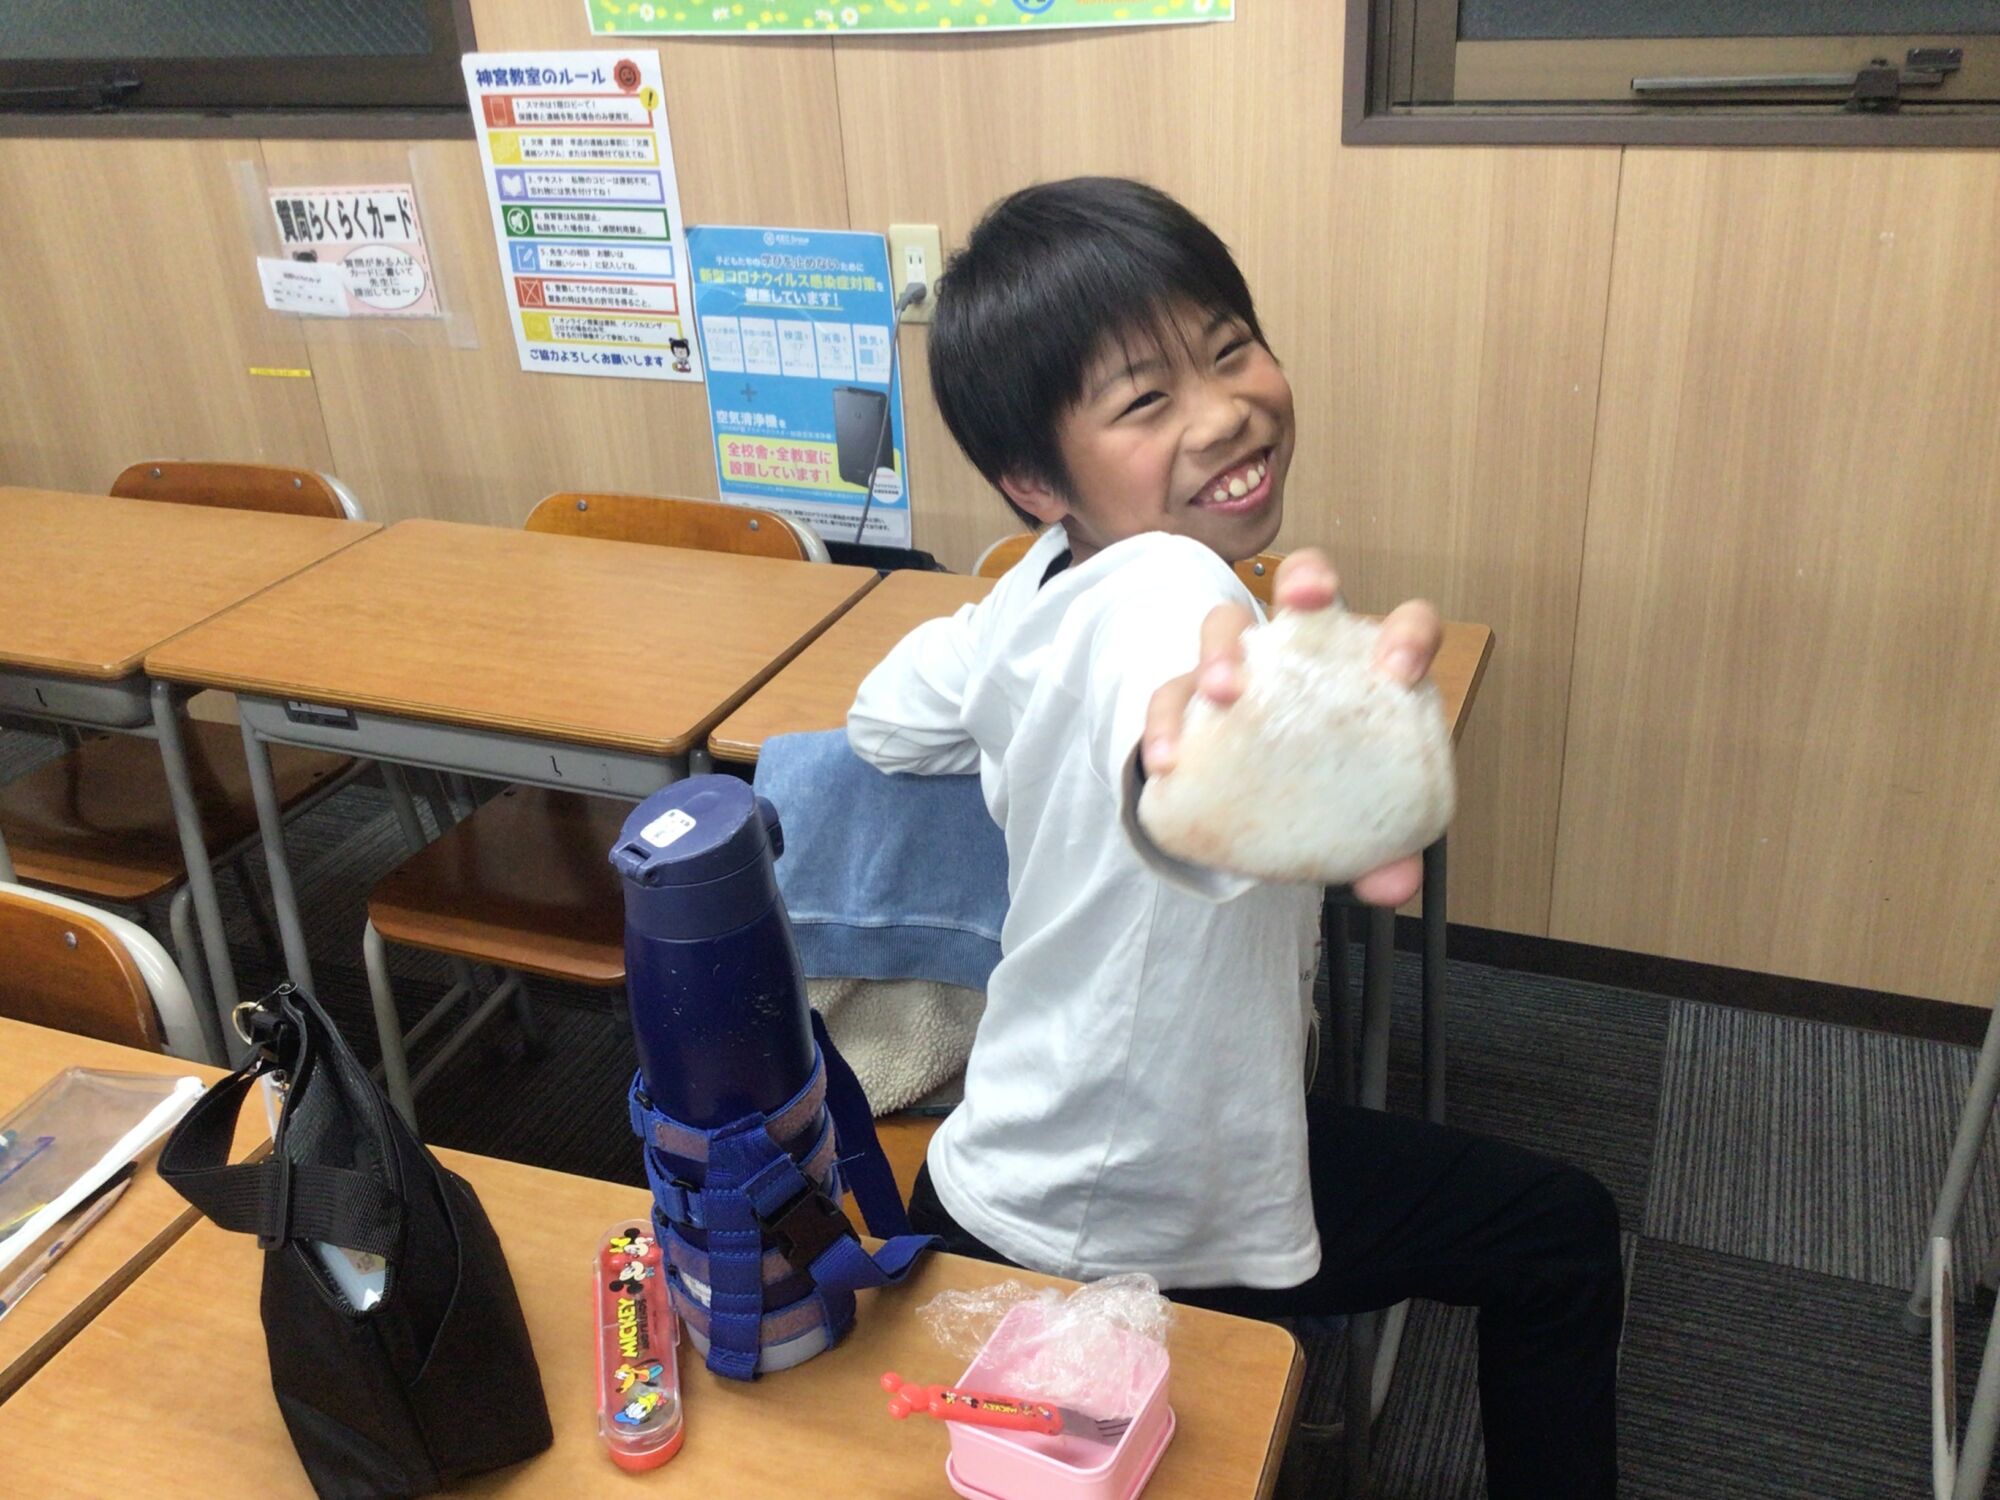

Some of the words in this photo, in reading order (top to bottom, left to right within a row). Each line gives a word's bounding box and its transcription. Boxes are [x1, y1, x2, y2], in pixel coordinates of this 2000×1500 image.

[476, 67, 606, 87] 神宮教室のルール
[275, 196, 412, 243] 質問らくらくカード
[344, 256, 414, 269] 質問がある人は
[350, 267, 414, 278] カードに書いて
[369, 277, 400, 287] 先生に
[529, 348, 664, 368] ご協力よろしくお願いします
[727, 442, 832, 465] 全校舎・全教室に
[617, 1297, 638, 1358] MICKEY
